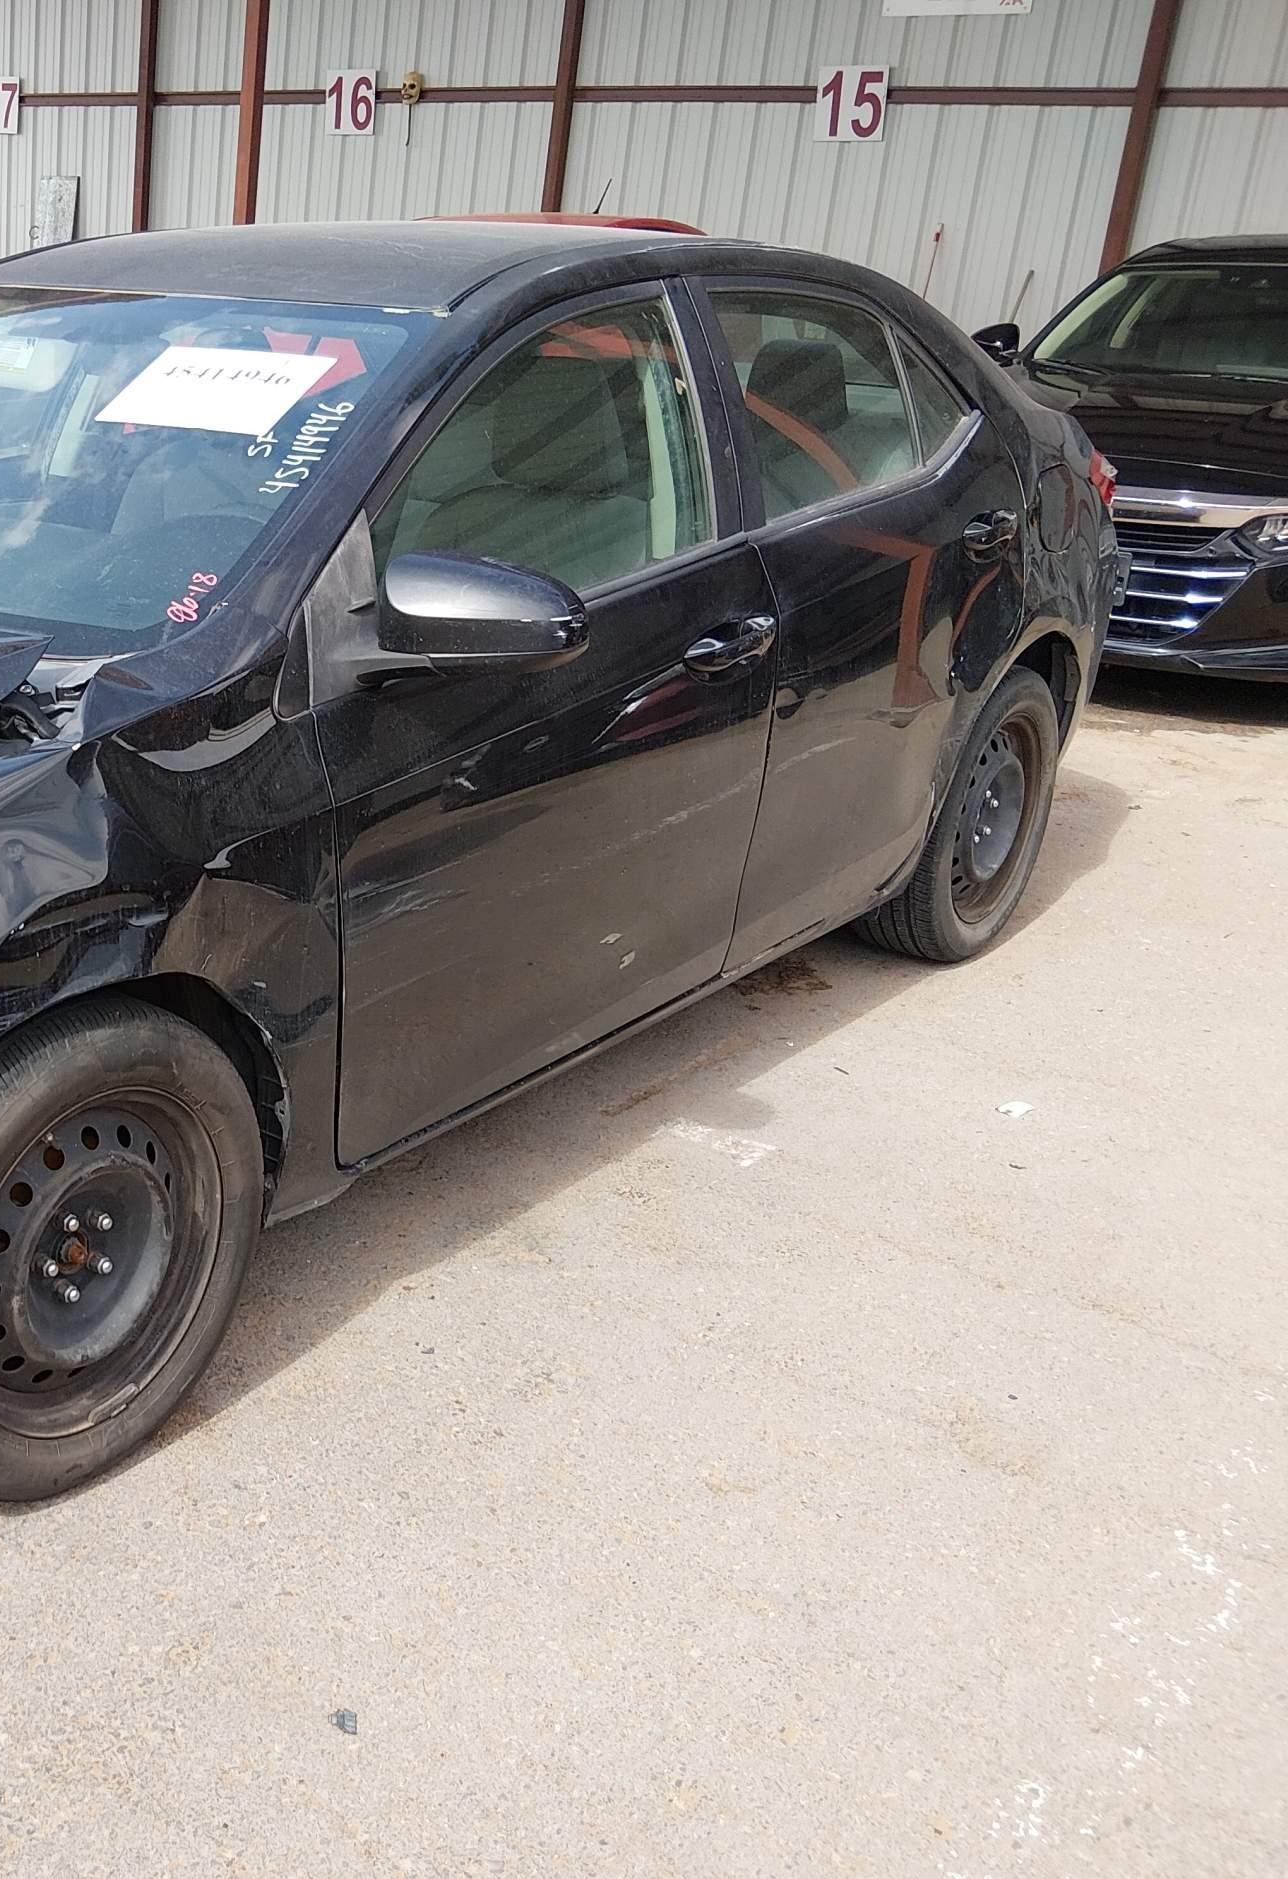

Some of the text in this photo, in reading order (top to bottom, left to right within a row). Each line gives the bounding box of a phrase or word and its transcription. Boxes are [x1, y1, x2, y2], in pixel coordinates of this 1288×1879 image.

[328, 76, 372, 130] 16
[820, 71, 884, 138] 15
[258, 401, 355, 493] 45414946
